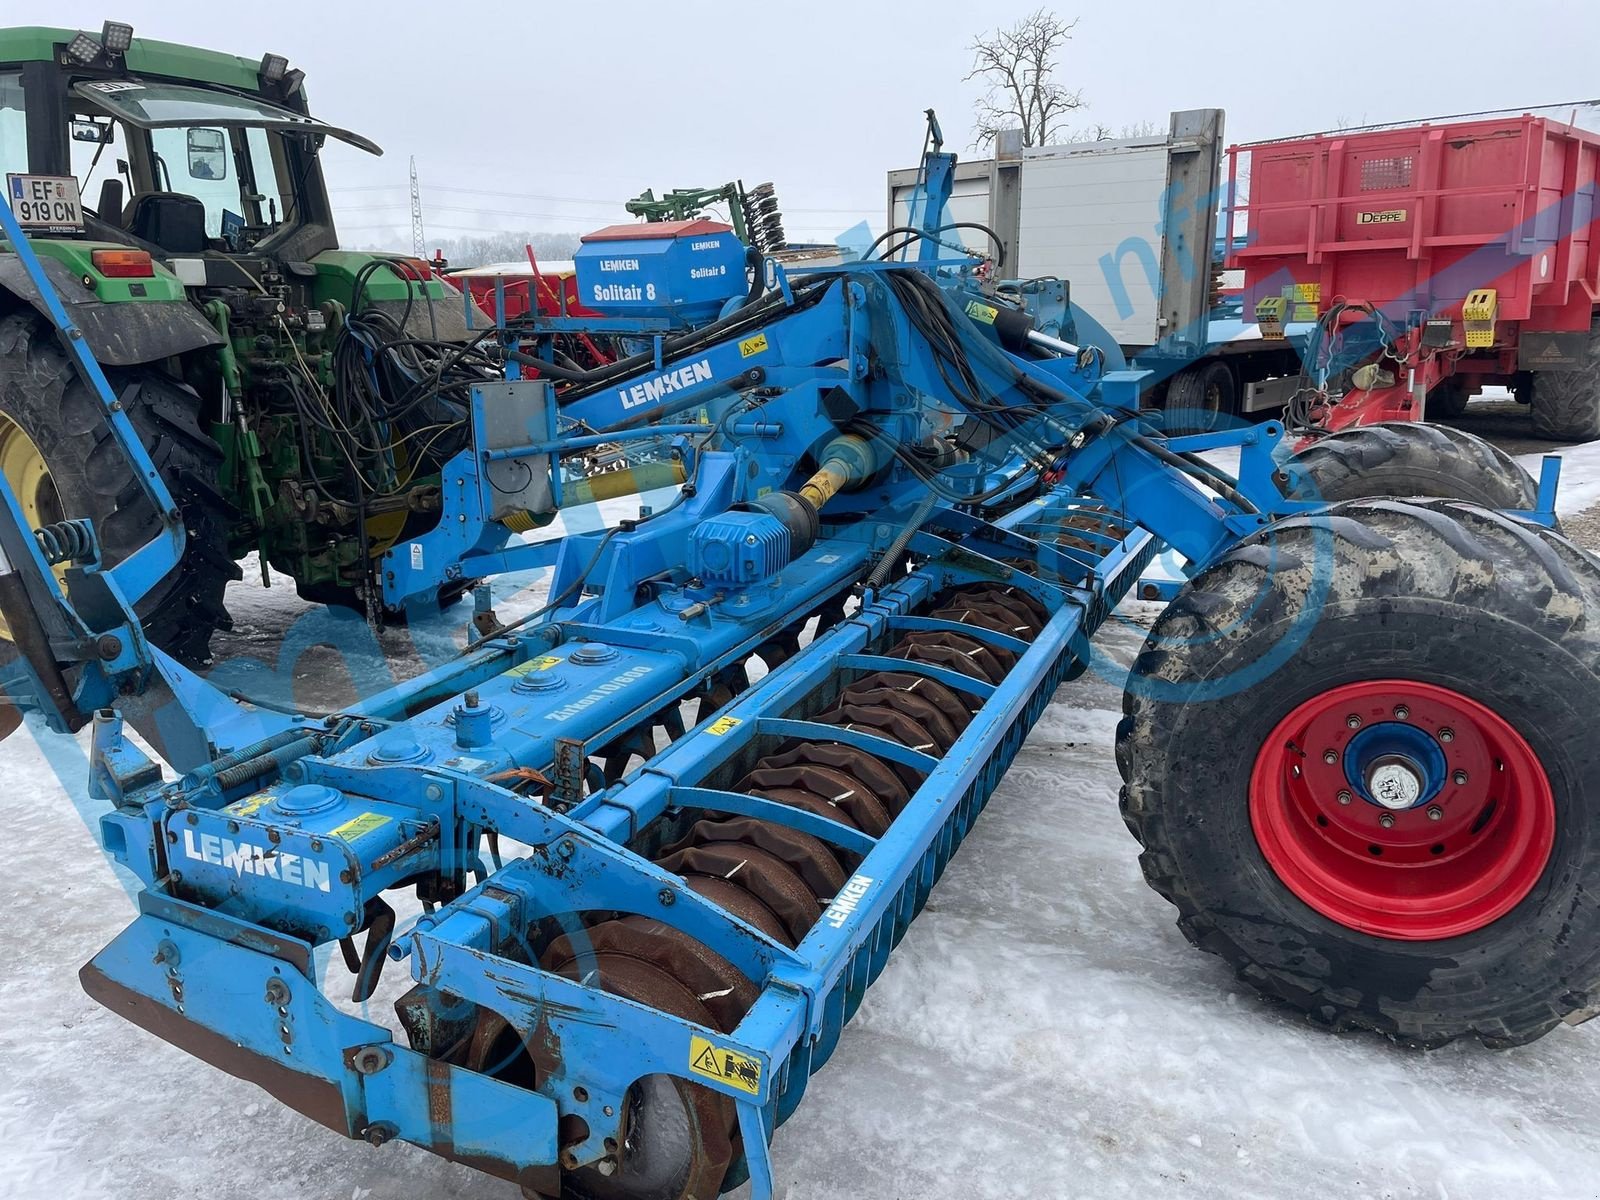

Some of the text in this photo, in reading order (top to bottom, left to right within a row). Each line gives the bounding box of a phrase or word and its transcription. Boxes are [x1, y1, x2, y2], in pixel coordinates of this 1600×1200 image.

[32, 181, 53, 200] EF
[20, 201, 76, 221] 919 CN
[1361, 212, 1401, 223] DEPPE
[691, 240, 720, 251] LEMKEN
[600, 259, 640, 273] LEMKEN
[690, 265, 726, 279] Solitair 8
[594, 283, 656, 301] Solitair 8
[619, 359, 713, 410] LEMKEN
[543, 692, 605, 722] Zirkon
[184, 829, 331, 893] LEMKEN
[824, 874, 874, 929] LEMKEN
